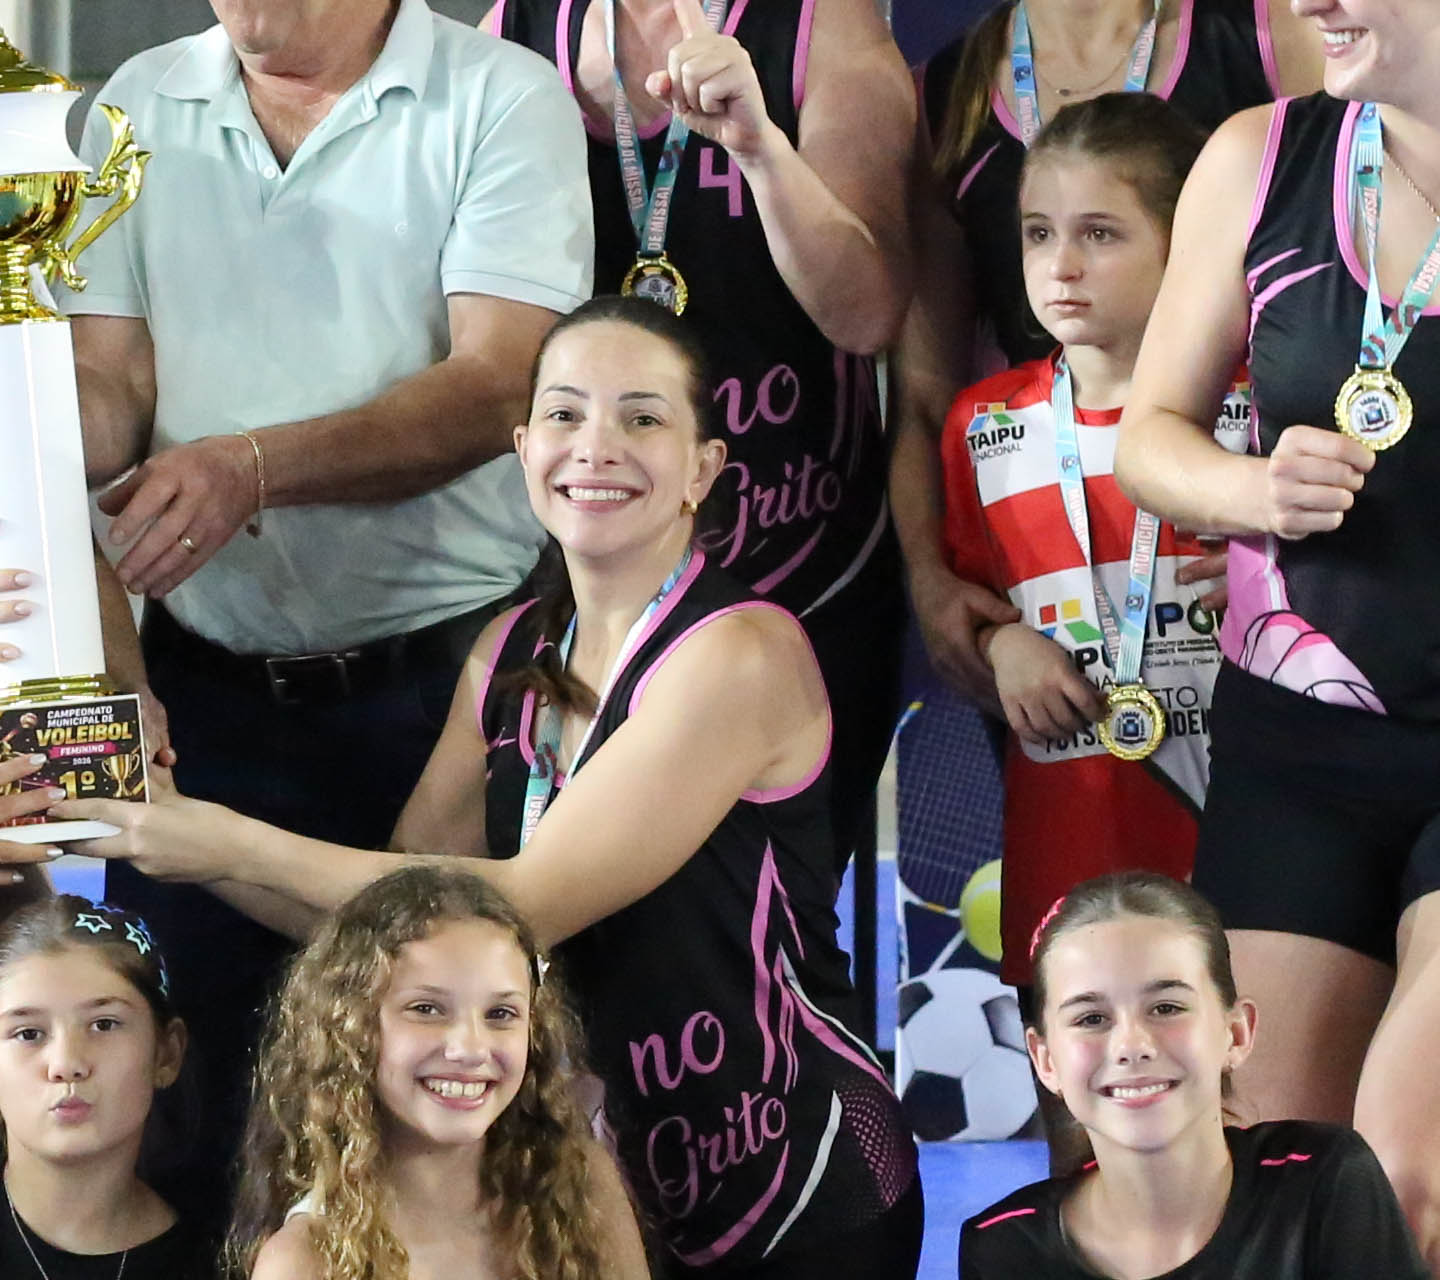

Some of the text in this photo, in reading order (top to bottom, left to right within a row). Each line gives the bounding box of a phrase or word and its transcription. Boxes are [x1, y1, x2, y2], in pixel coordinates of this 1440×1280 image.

[967, 425, 1025, 451] TAIPU
[36, 722, 133, 747] VOLEIBOL
[629, 1009, 725, 1098] no
[646, 1092, 788, 1219] Grito
